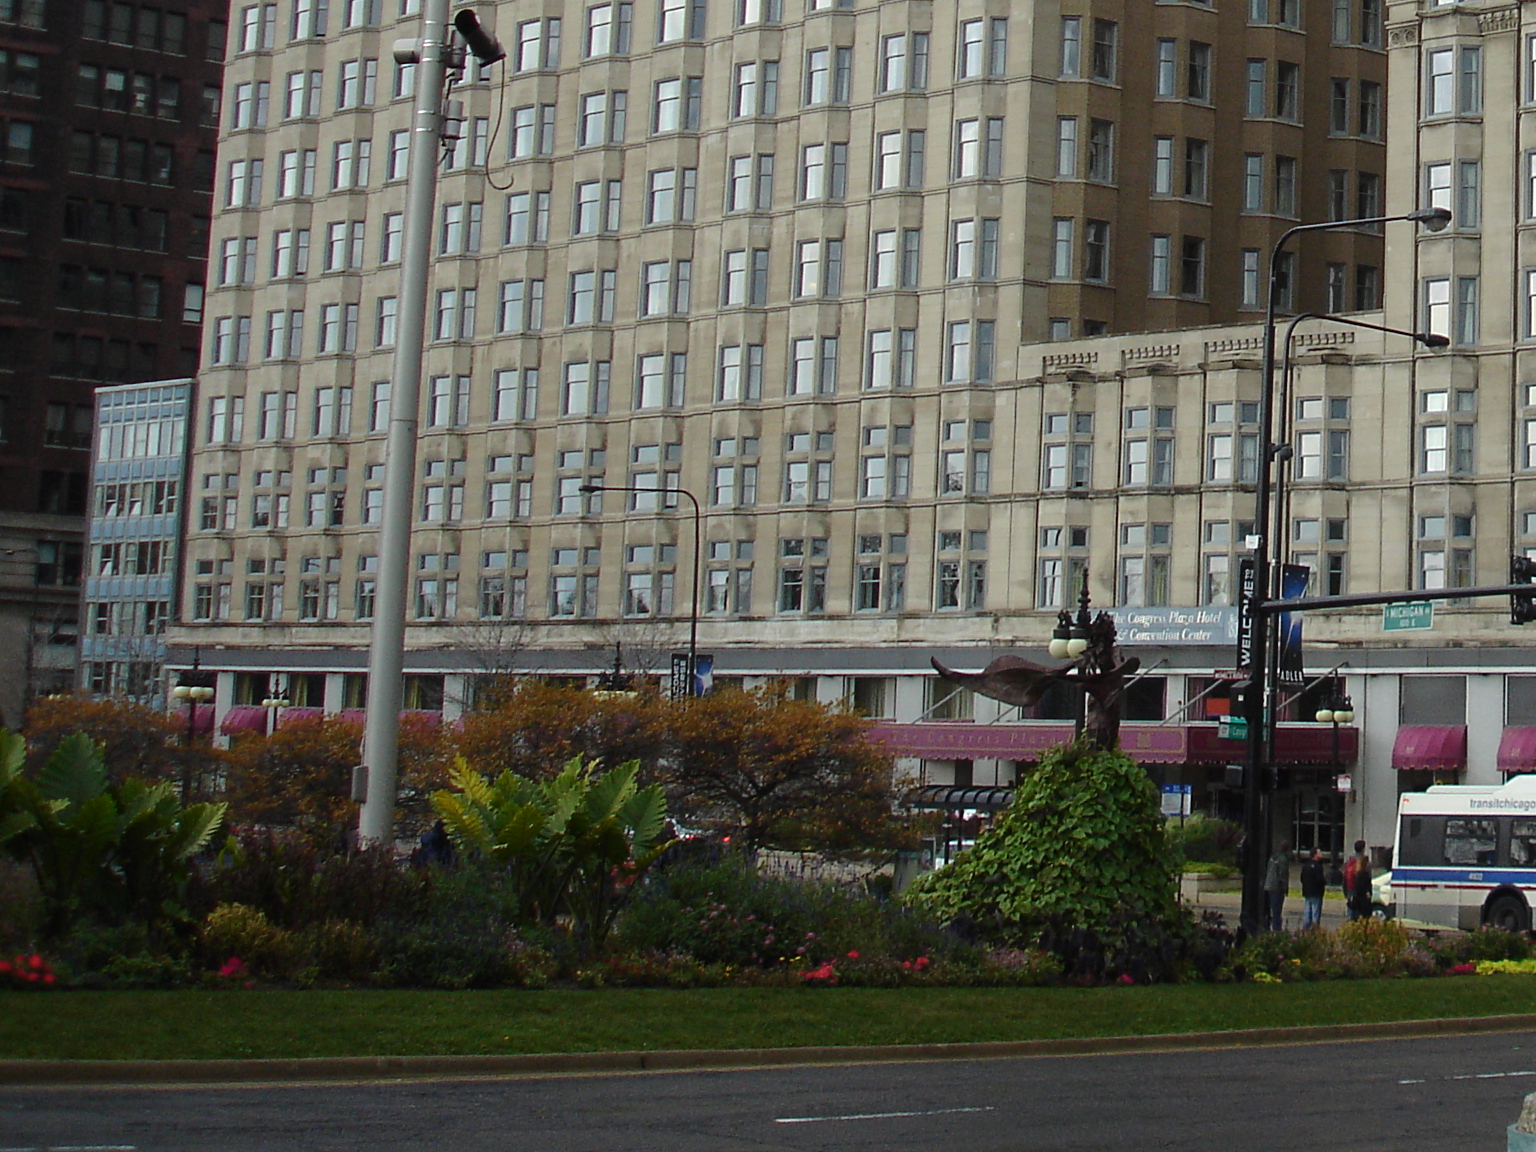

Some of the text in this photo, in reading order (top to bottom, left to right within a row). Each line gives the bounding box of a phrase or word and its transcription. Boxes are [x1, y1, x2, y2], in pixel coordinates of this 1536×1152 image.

[1127, 612, 1166, 627] Congress
[1169, 611, 1194, 625] Plaza
[1196, 611, 1221, 624] Hotel
[1130, 628, 1180, 641] Convention
[1181, 628, 1212, 641] Center
